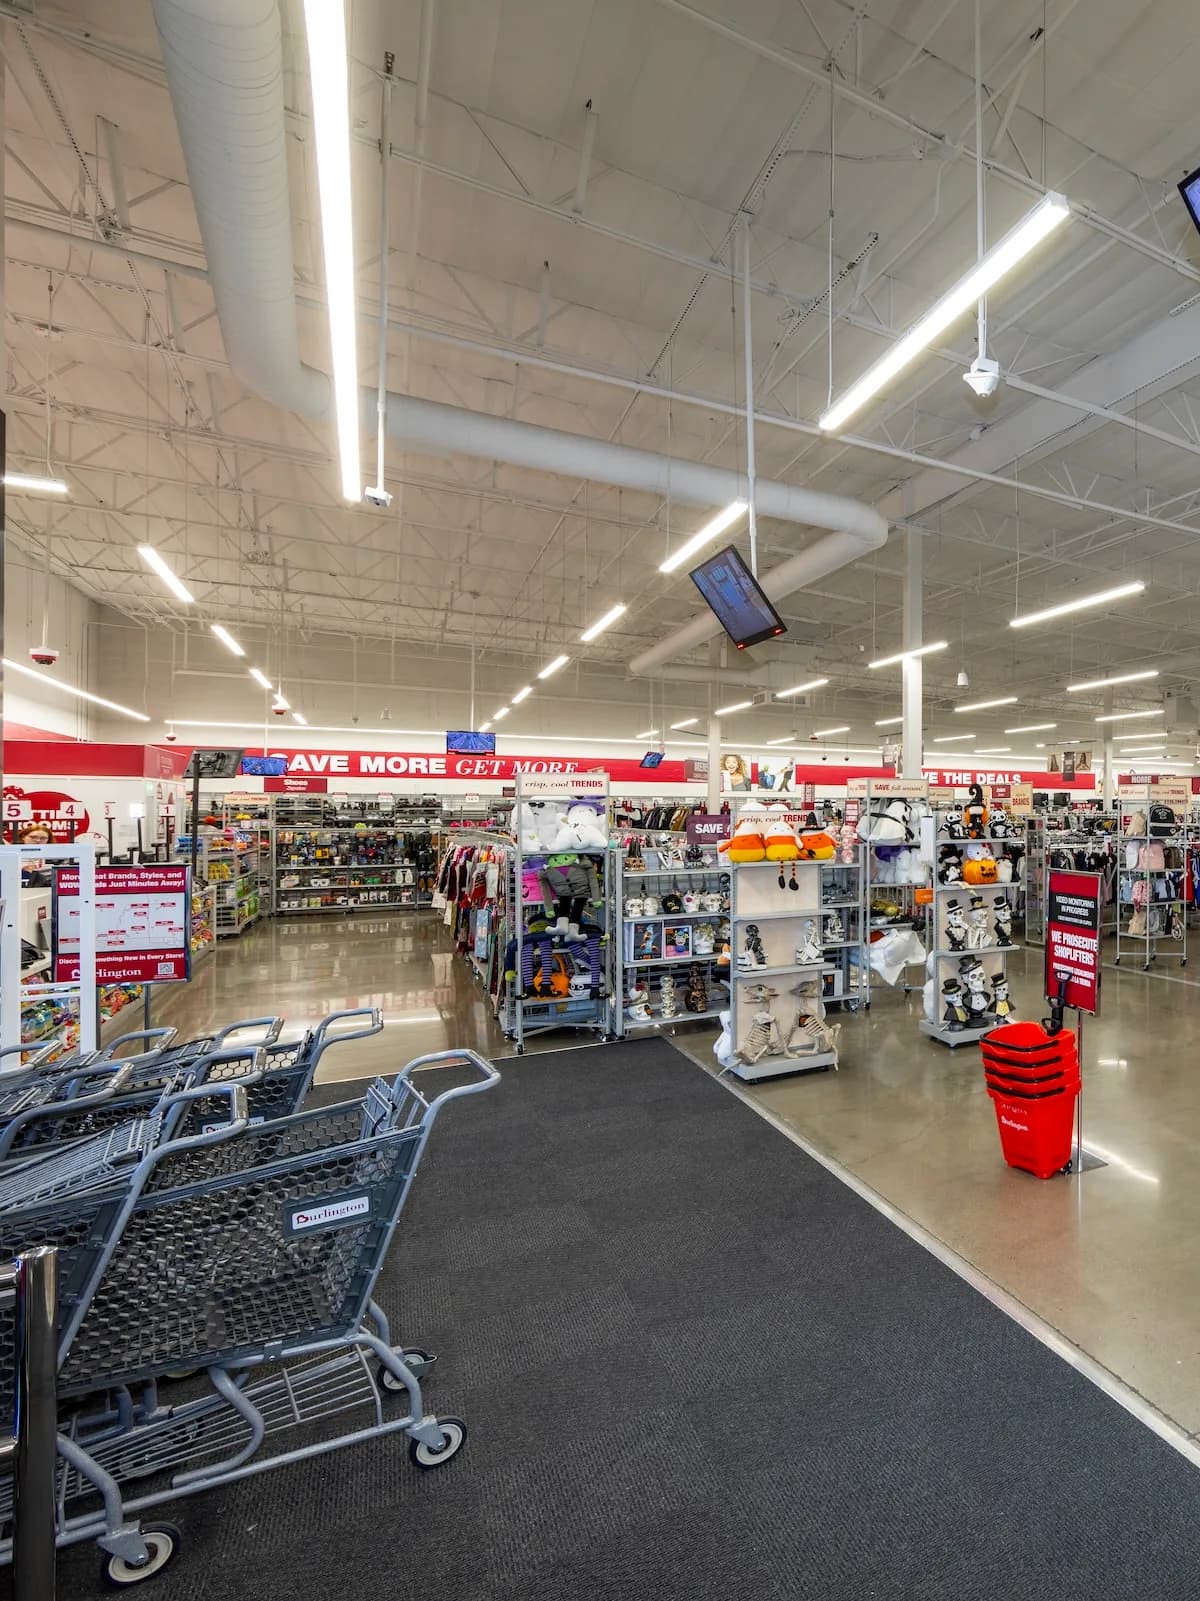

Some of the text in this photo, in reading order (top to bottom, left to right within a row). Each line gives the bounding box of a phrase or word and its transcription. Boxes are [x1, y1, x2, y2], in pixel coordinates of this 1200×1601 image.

[270, 753, 579, 776] AVE MORE GET MORE
[943, 772, 972, 784] THE
[976, 773, 1021, 785] DEALS
[525, 780, 603, 789] crisp, cool TRENDS
[7, 803, 21, 817] 5
[65, 804, 75, 816] 4
[164, 806, 169, 815] 1
[743, 814, 809, 825] crisp, cool TREND
[695, 823, 724, 834] SAVE
[62, 873, 80, 881] Mor
[108, 872, 139, 880] Brands,
[140, 871, 166, 879] Styles,
[160, 879, 184, 888] Away!
[1051, 930, 1098, 952] WE PROSECUTE
[95, 955, 123, 963] mething
[147, 953, 165, 961] Every
[1054, 945, 1095, 966] SHOPLIFTERS
[296, 1203, 365, 1225] Burlington
